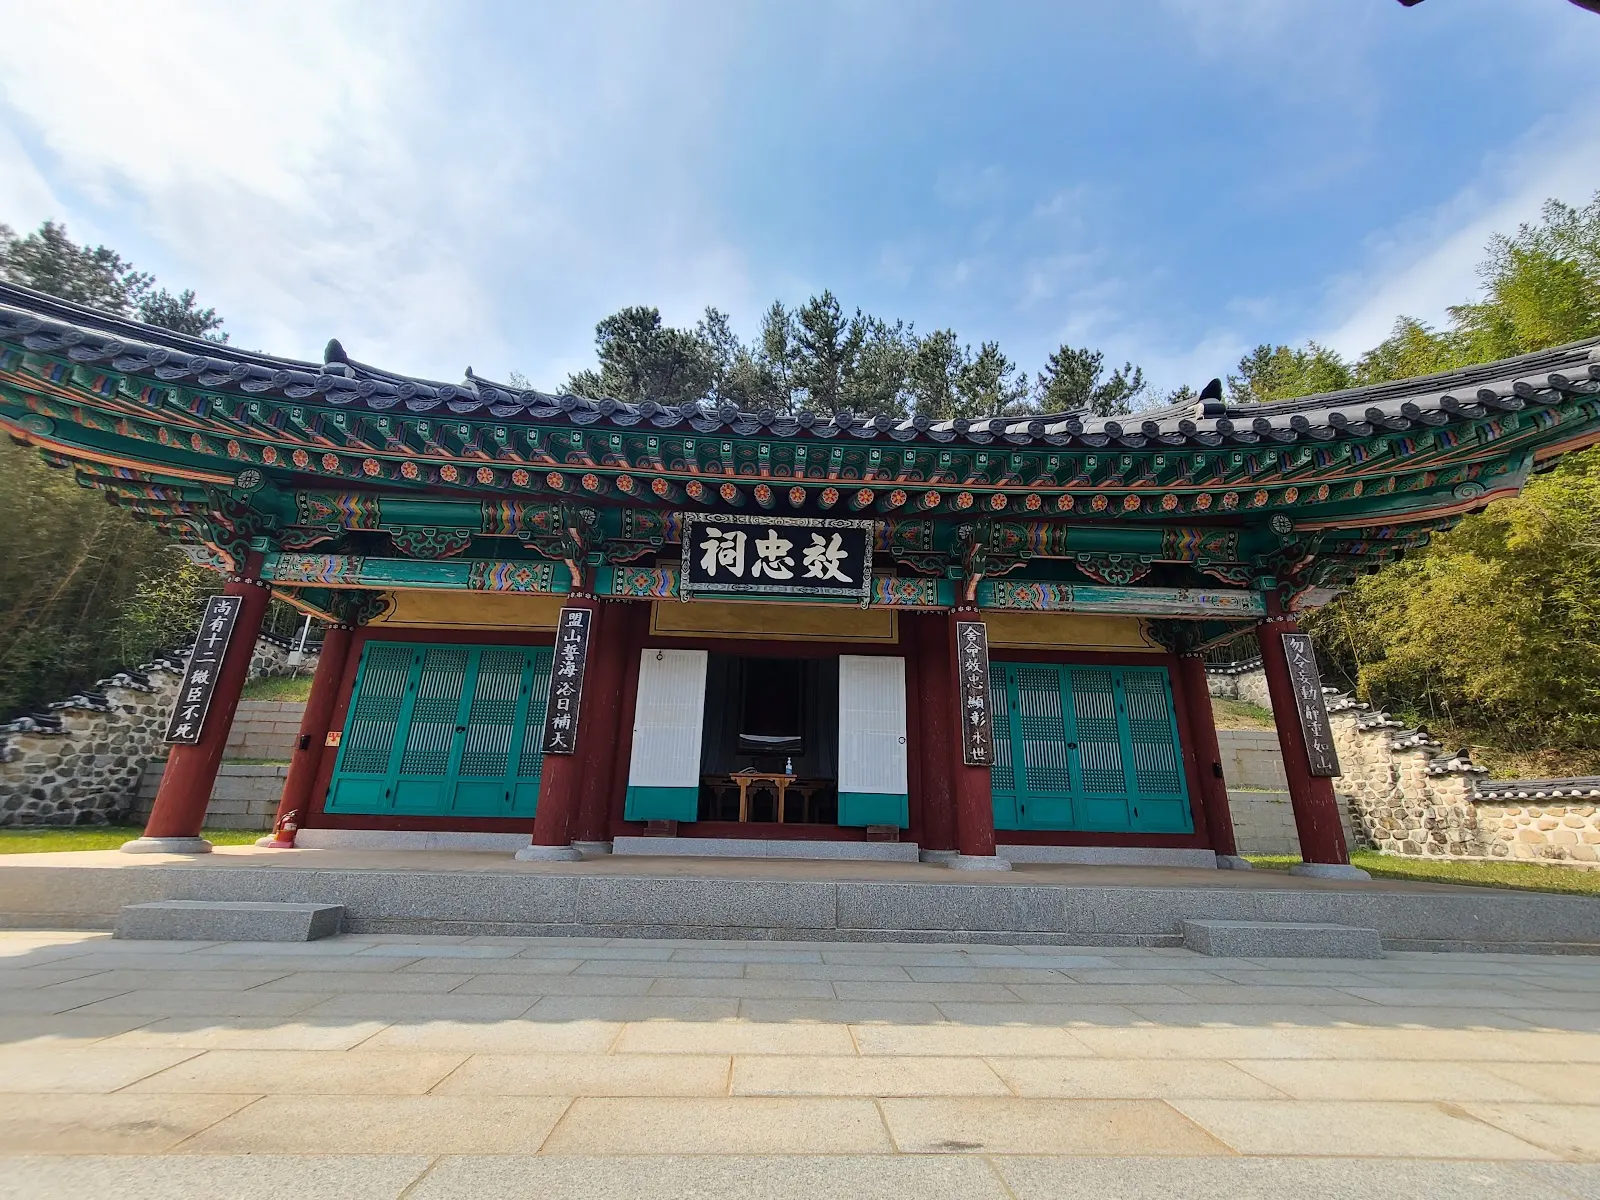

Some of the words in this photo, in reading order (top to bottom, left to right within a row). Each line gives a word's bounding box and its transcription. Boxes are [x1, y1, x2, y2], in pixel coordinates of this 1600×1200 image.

[171, 600, 230, 739] 尚有十二微臣不死
